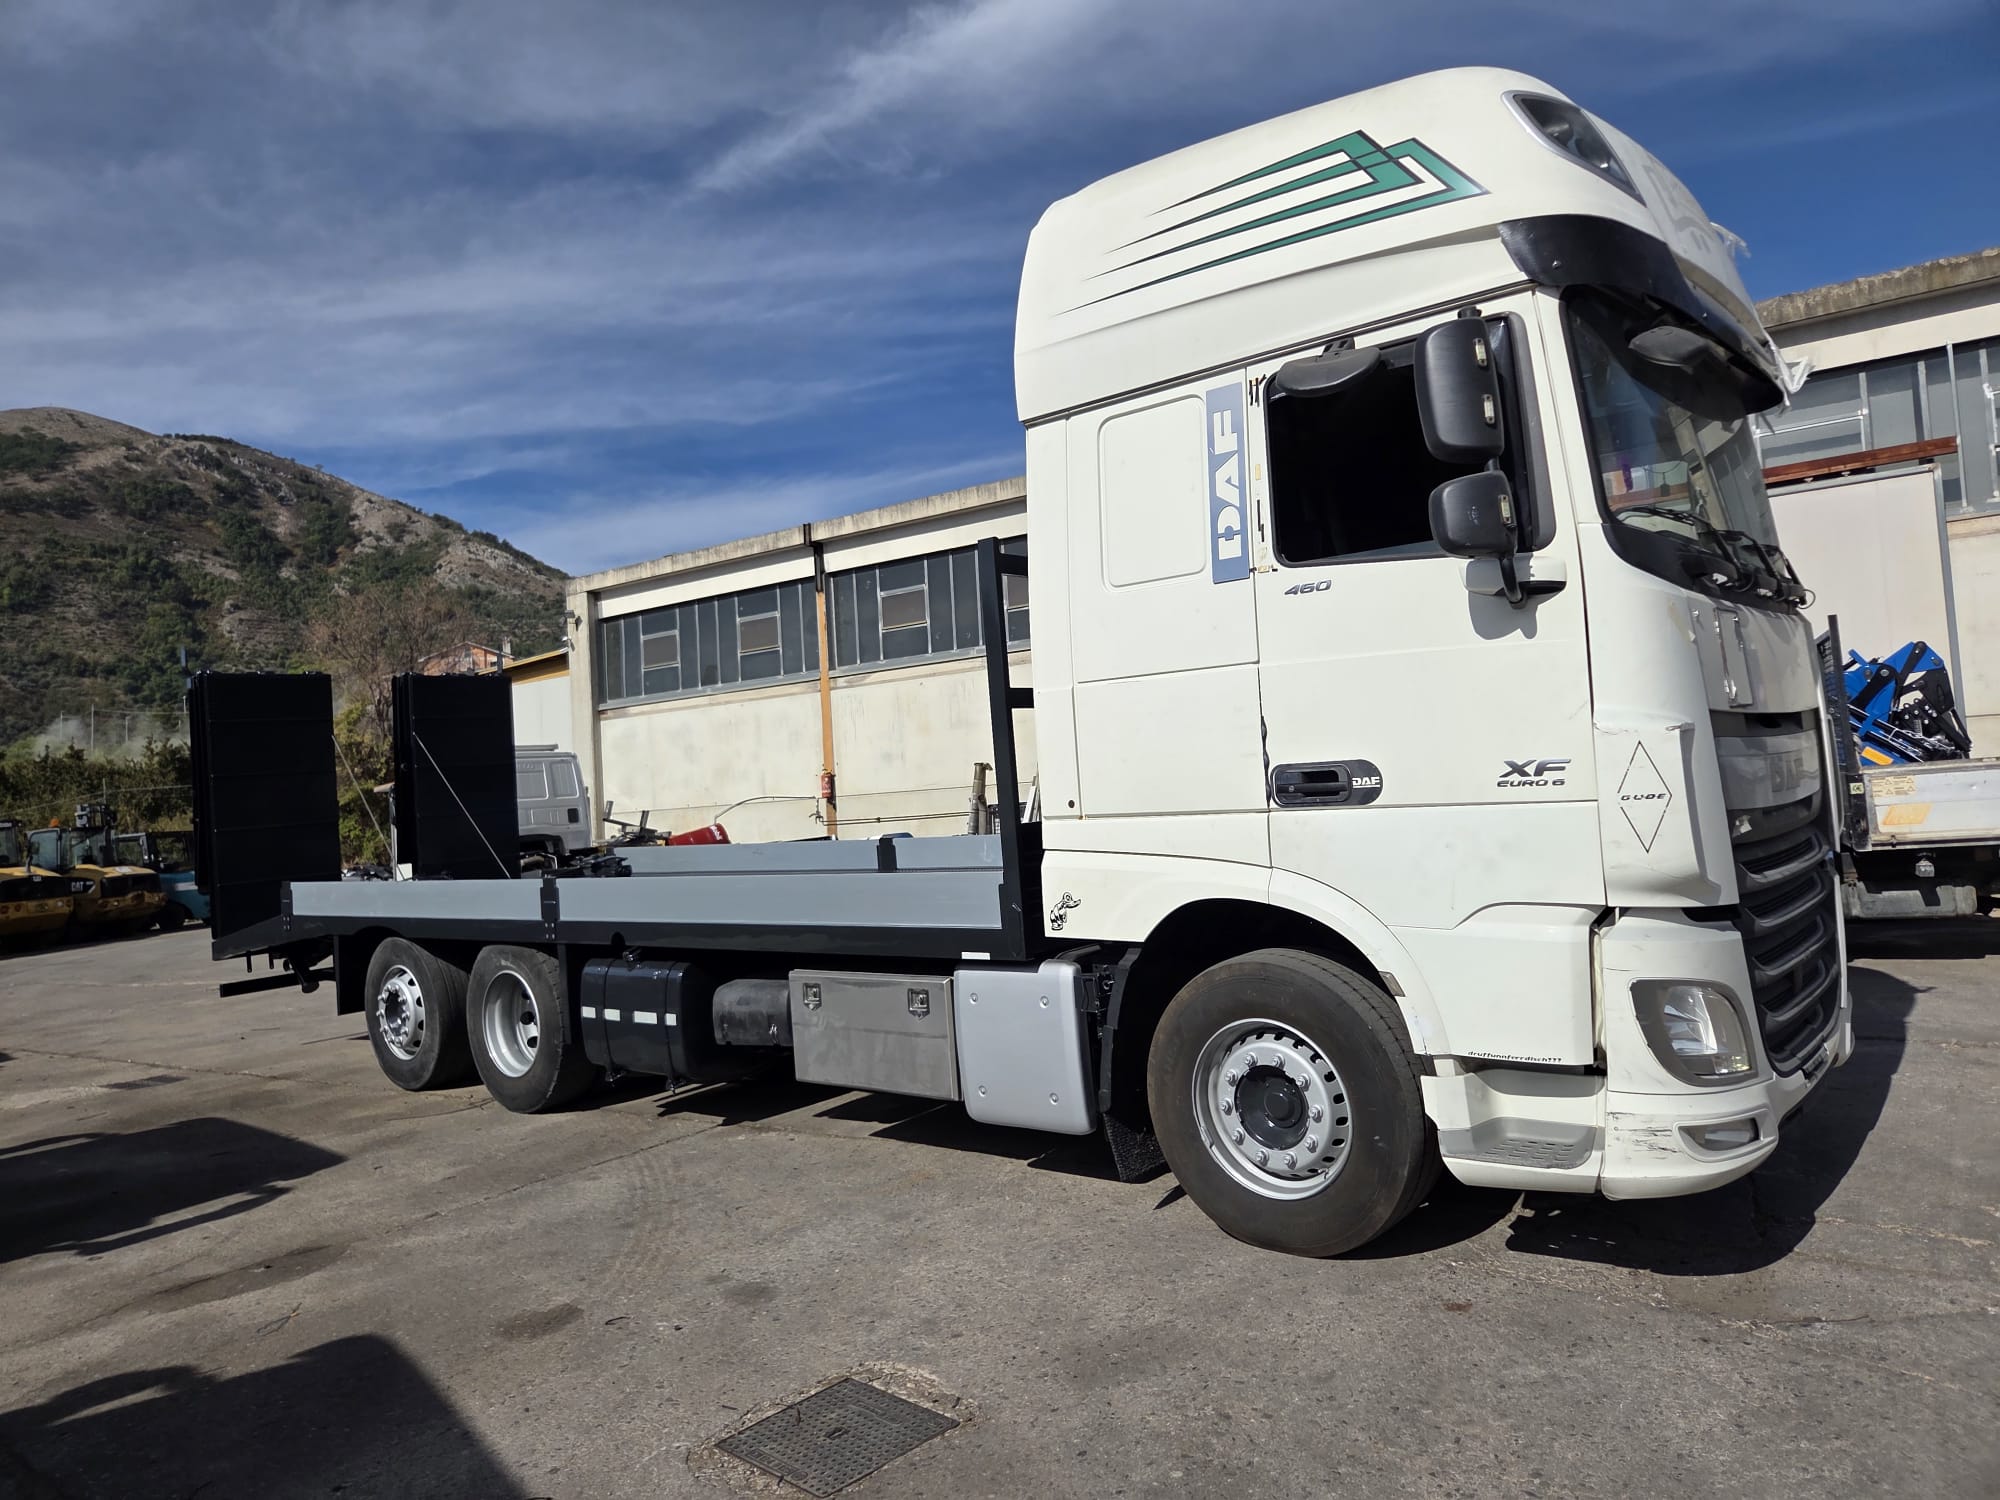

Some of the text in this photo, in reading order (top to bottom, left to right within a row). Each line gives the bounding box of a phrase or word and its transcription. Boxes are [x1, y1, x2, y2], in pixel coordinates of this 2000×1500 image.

[1213, 409, 1242, 560] DAF
[1284, 579, 1332, 595] 460
[1499, 759, 1571, 778] XF
[1352, 776, 1380, 787] DAF
[1497, 778, 1566, 788] EURO 6
